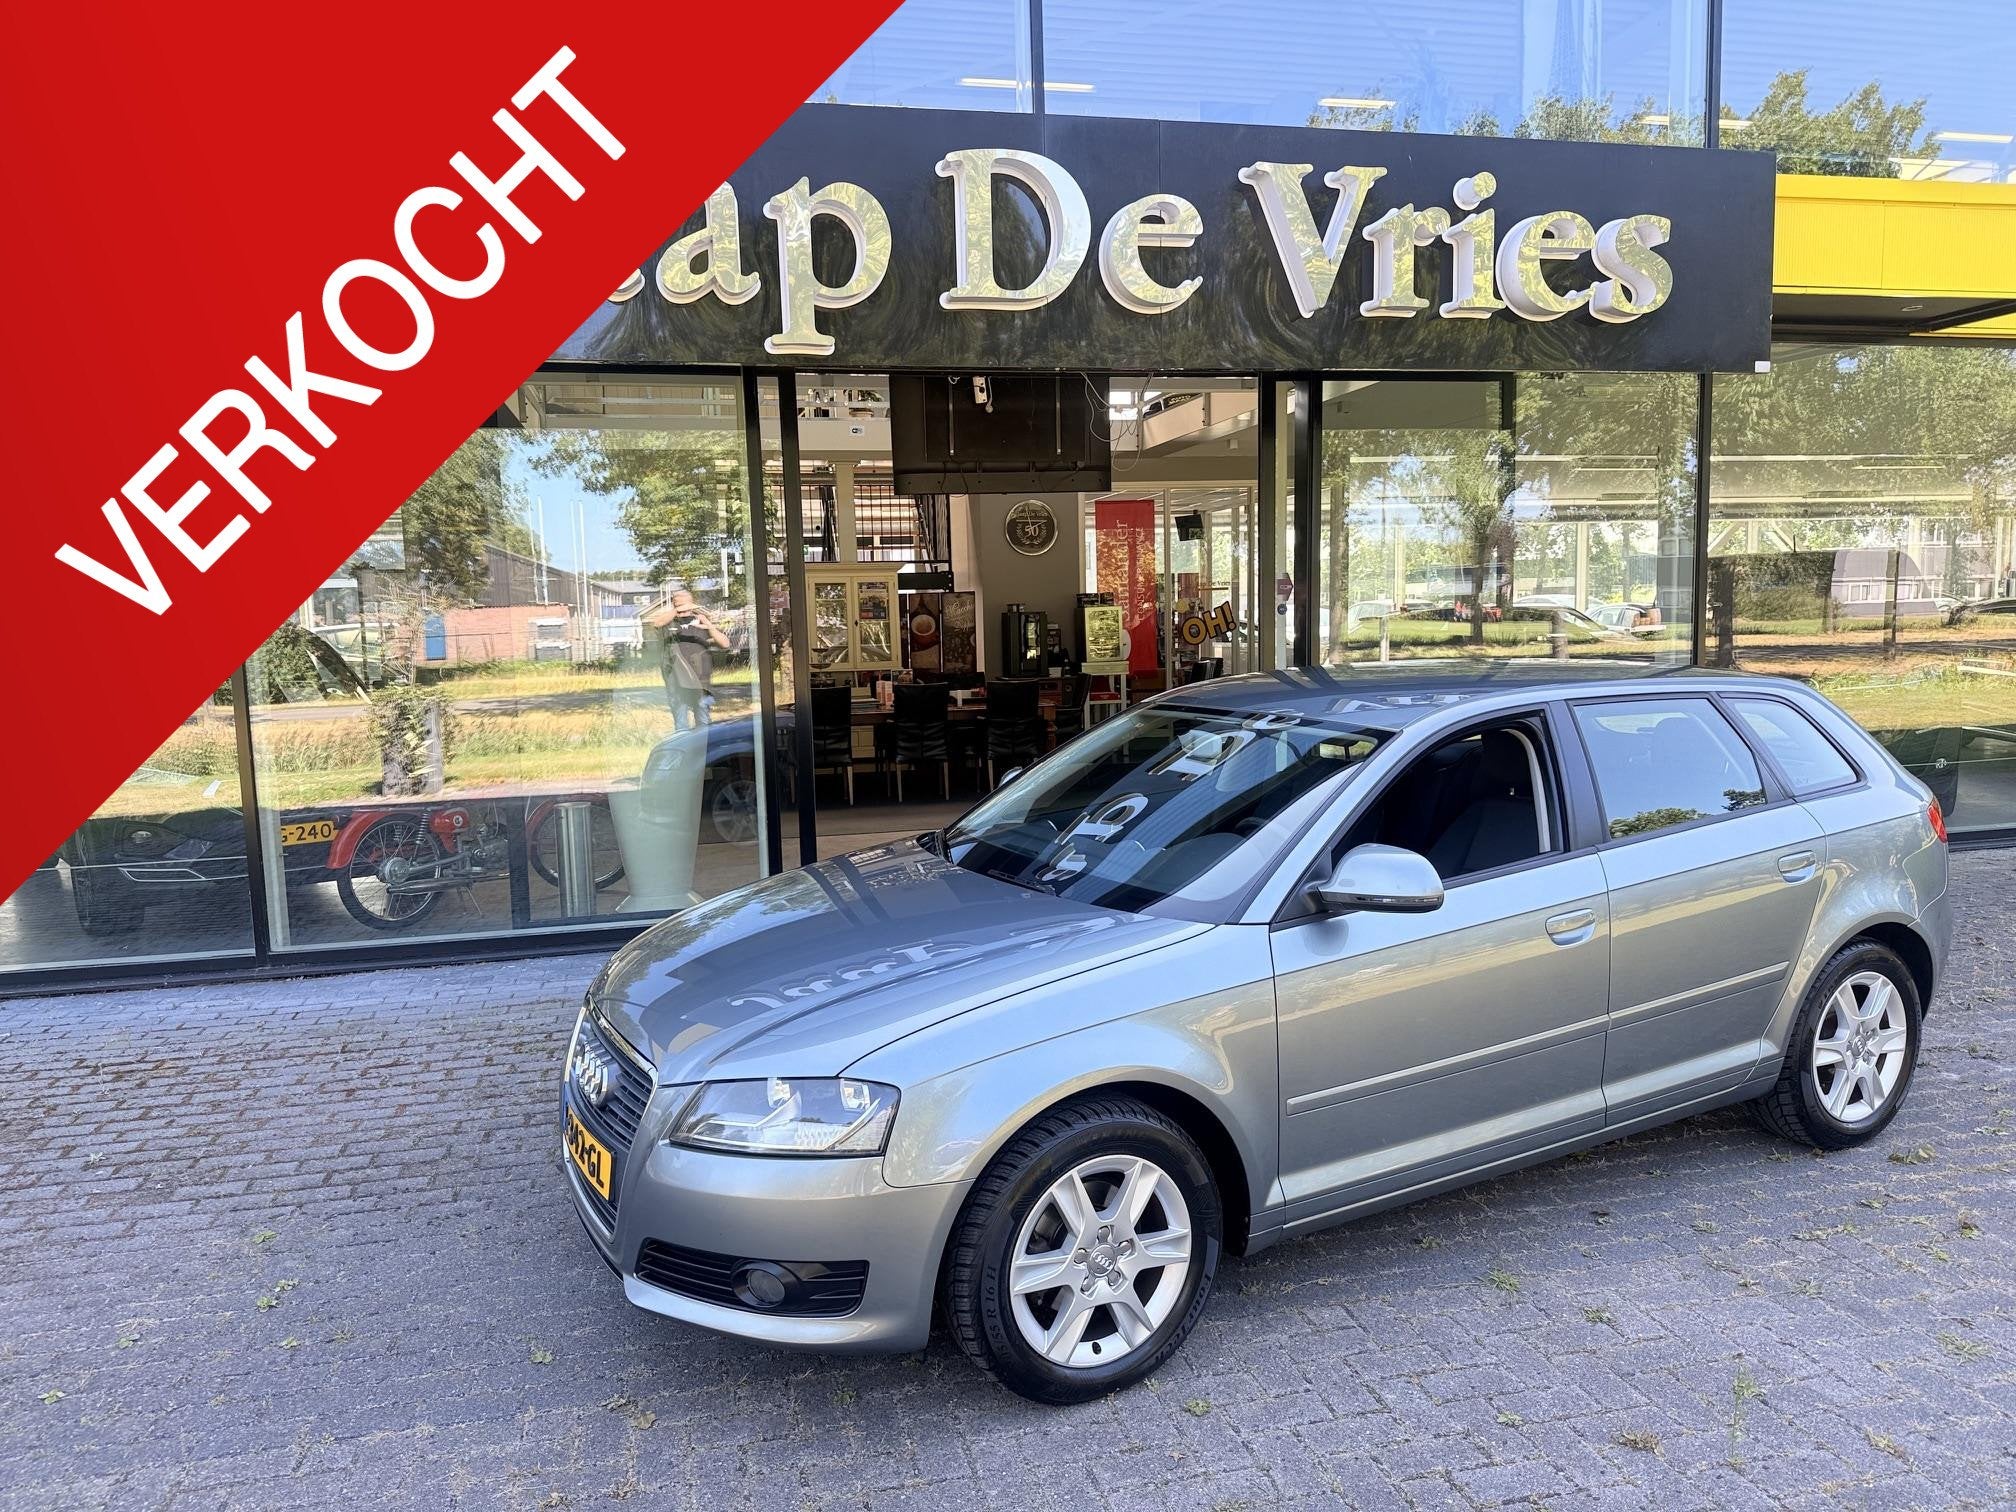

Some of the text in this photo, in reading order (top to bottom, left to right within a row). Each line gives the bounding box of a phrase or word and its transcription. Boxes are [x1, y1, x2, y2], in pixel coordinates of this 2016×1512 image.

[607, 147, 1674, 357] ap De Vries
[1182, 600, 1237, 645] OH!
